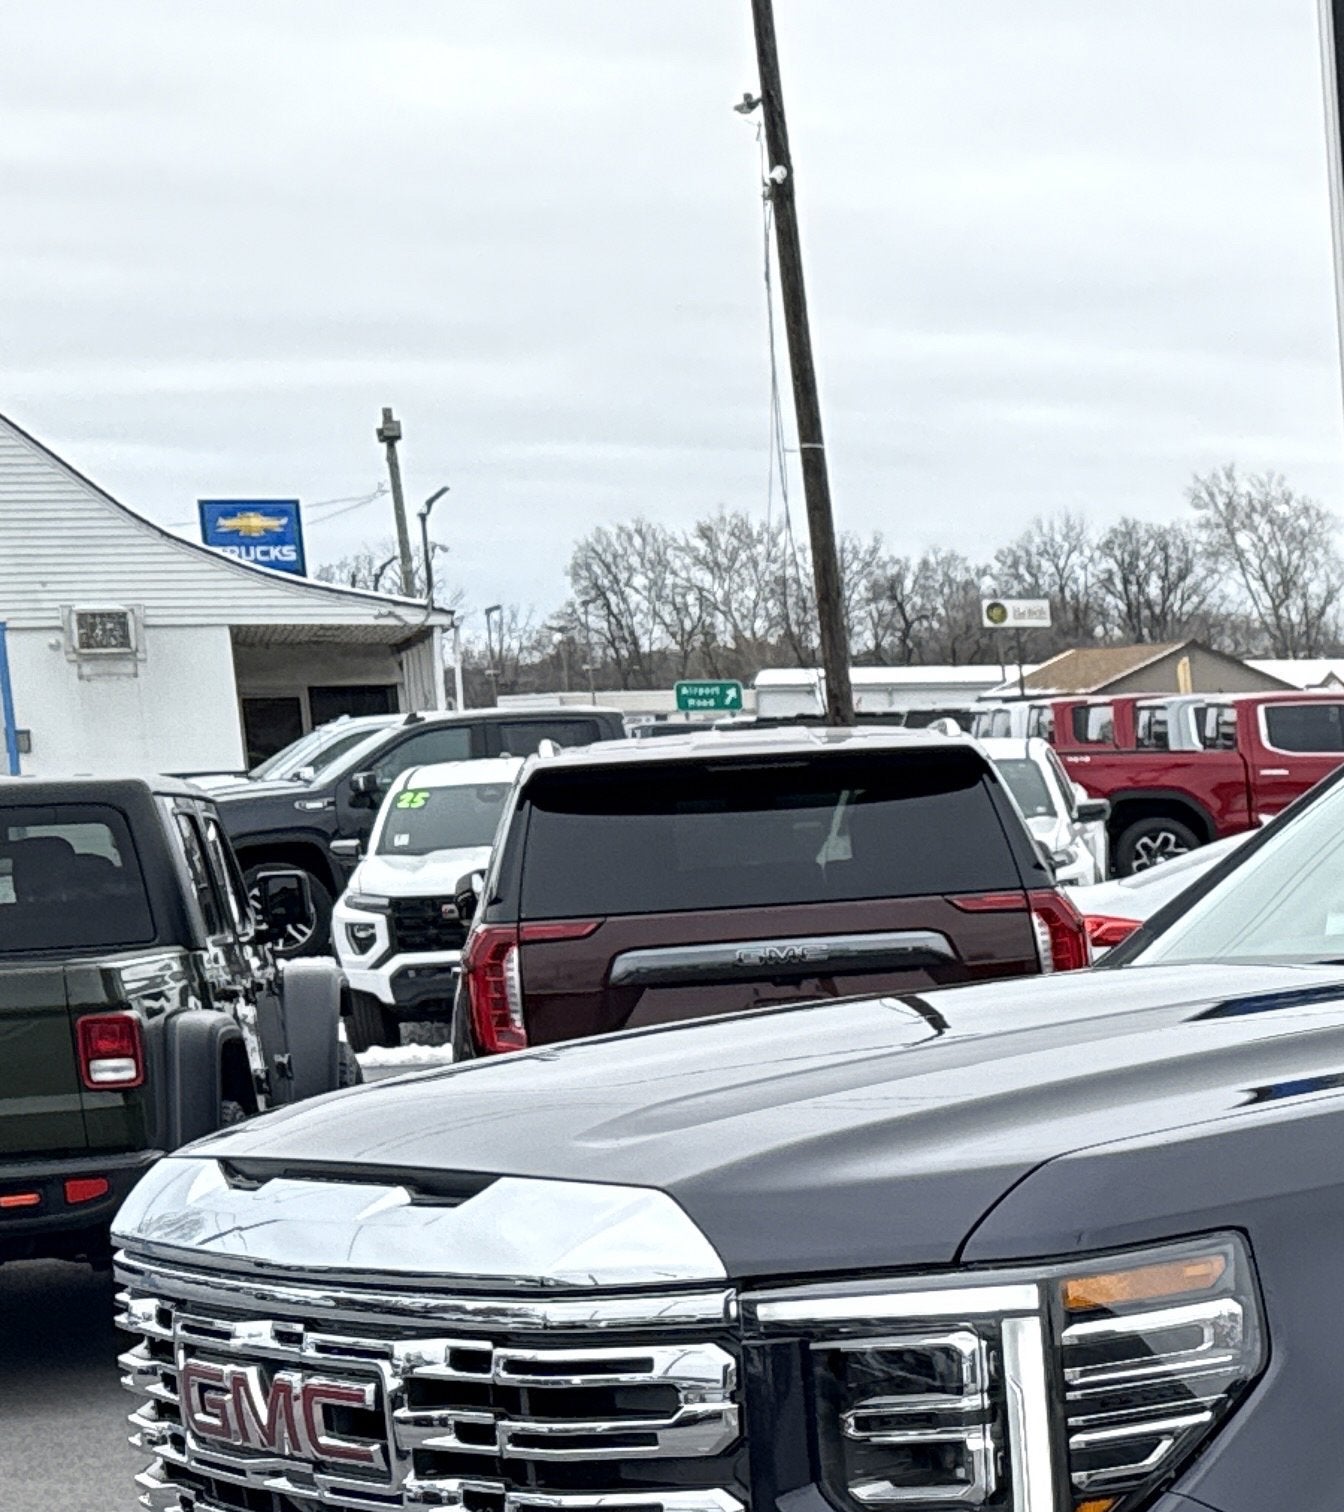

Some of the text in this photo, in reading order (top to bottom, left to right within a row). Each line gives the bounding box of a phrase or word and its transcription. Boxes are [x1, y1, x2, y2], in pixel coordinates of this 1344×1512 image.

[221, 546, 297, 561] RUCKS
[680, 686, 720, 697] Airport
[396, 791, 430, 809] 25
[736, 945, 829, 966] GMC
[184, 1358, 388, 1470] GMC
